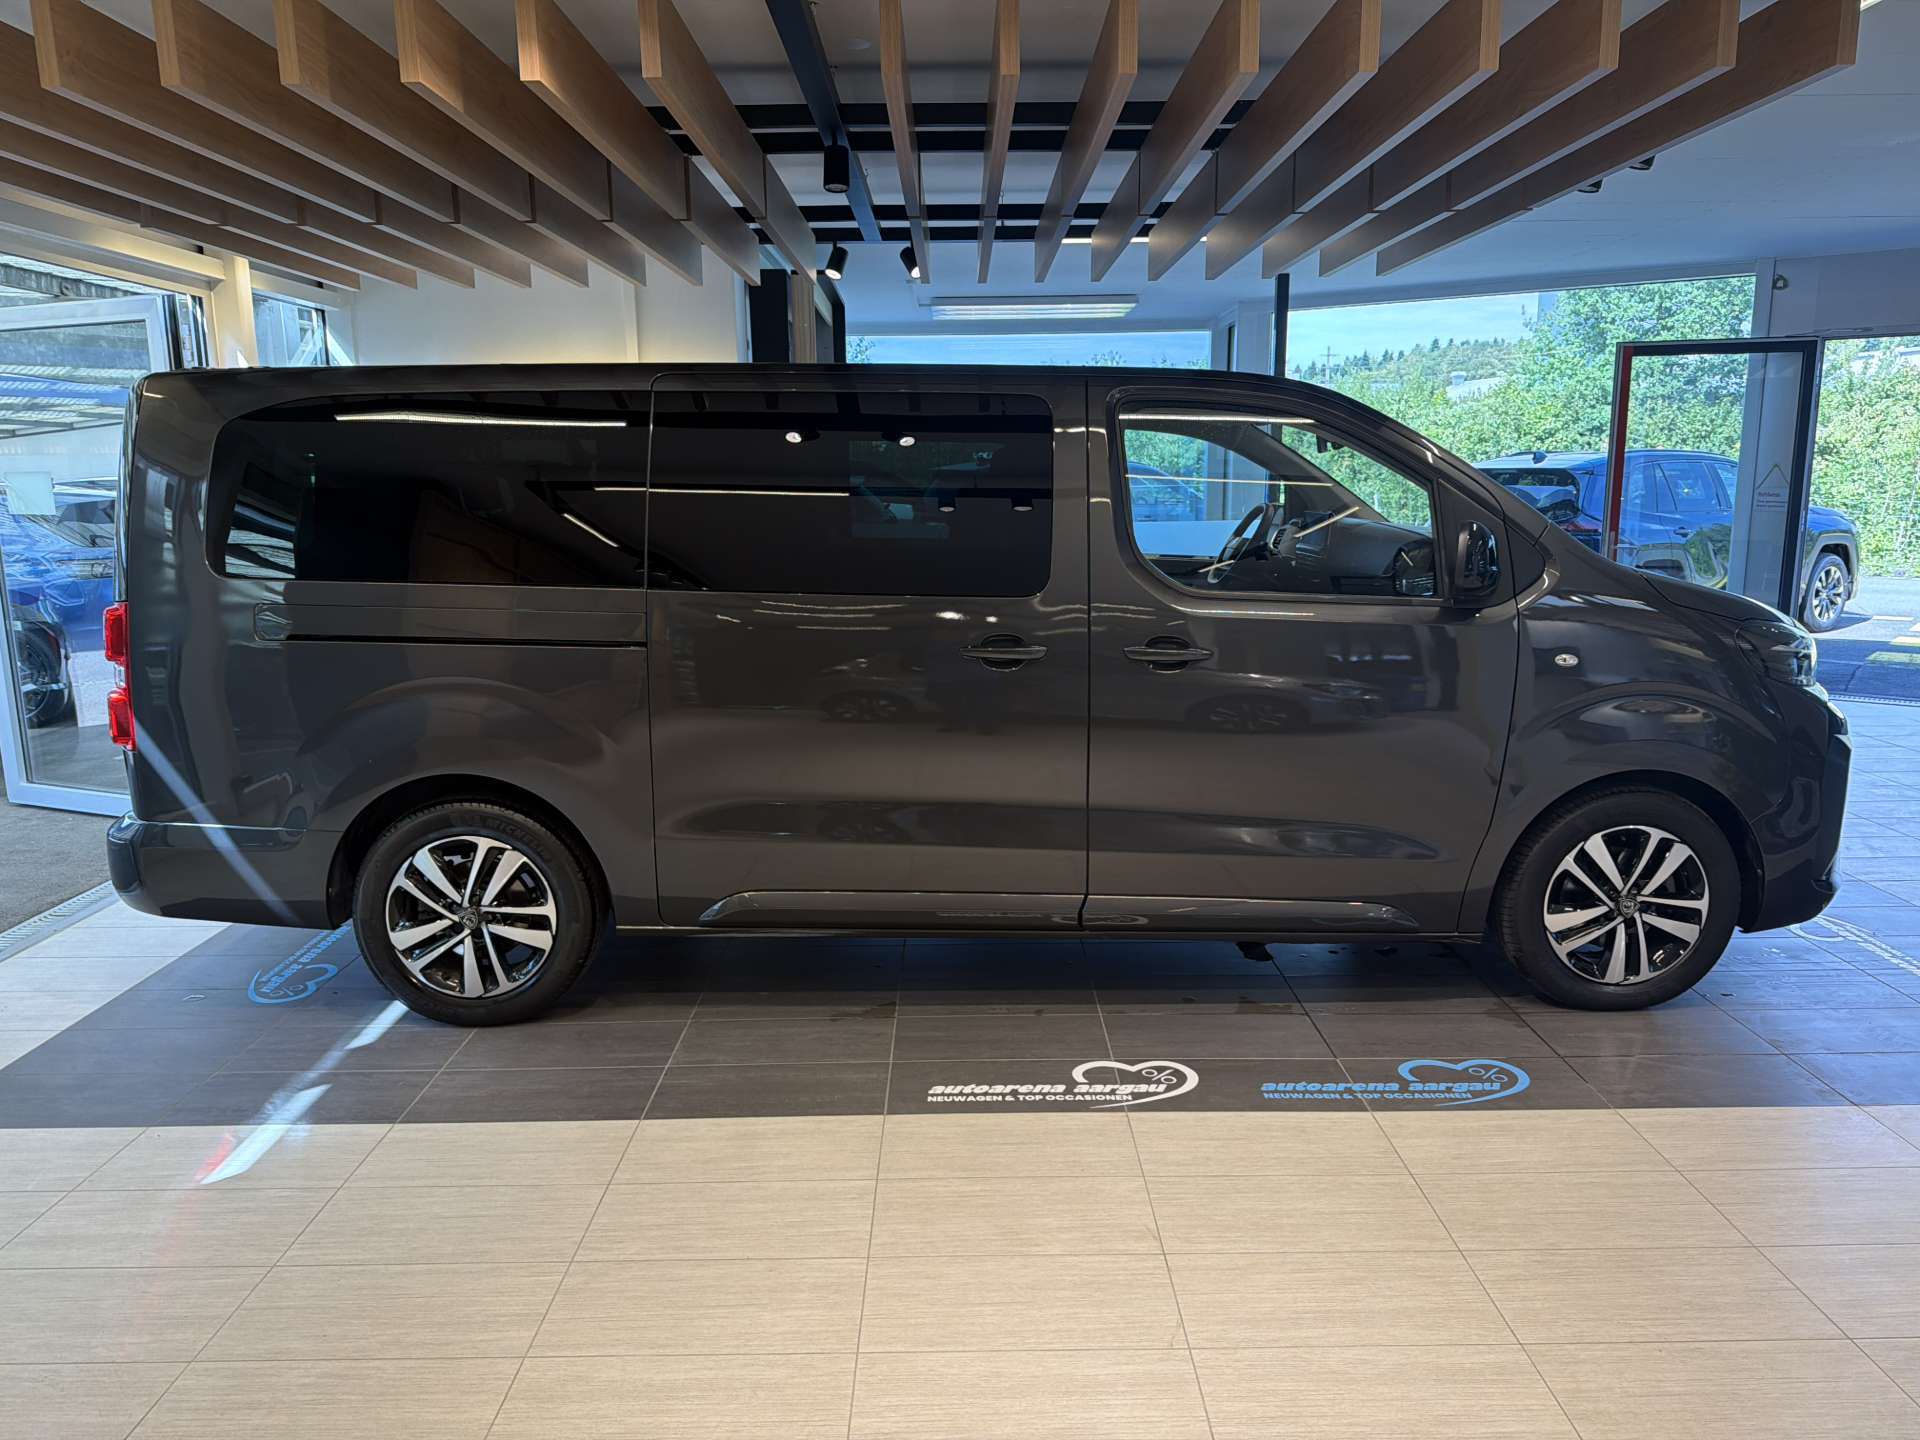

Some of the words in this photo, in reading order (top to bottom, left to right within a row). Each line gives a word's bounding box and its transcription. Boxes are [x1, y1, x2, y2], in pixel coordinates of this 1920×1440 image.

[927, 1083, 1067, 1094] autoarena
[1073, 1083, 1168, 1094] aargau
[1261, 1081, 1400, 1092] autoarena
[1408, 1081, 1501, 1092] aargau
[927, 1094, 1001, 1102] NEUWAGEN
[1004, 1094, 1015, 1102] &
[1046, 1093, 1133, 1101] OCCASIONEN
